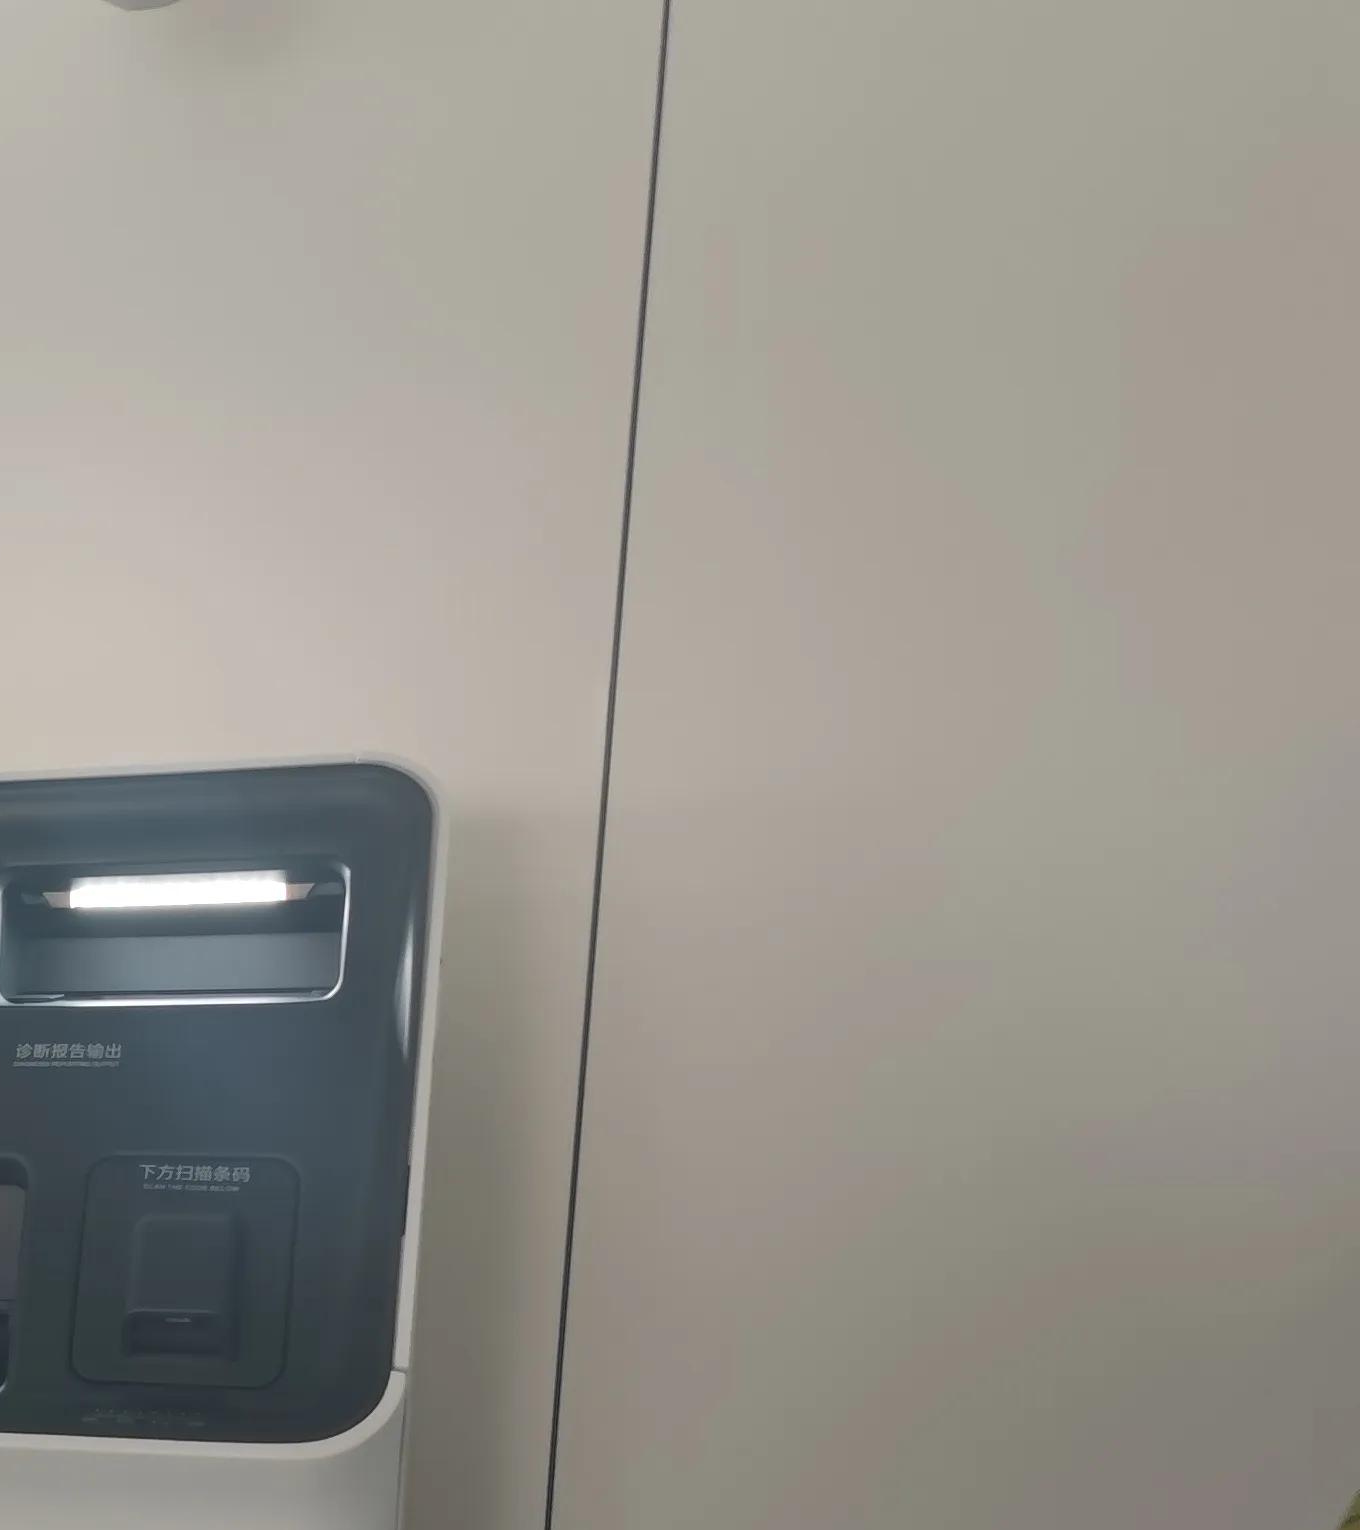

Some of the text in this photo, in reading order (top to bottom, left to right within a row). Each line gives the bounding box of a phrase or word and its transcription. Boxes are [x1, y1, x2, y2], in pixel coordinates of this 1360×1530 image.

[15, 1043, 122, 1059] 诊断报告输出
[139, 1164, 251, 1182] 下方扫描条码
